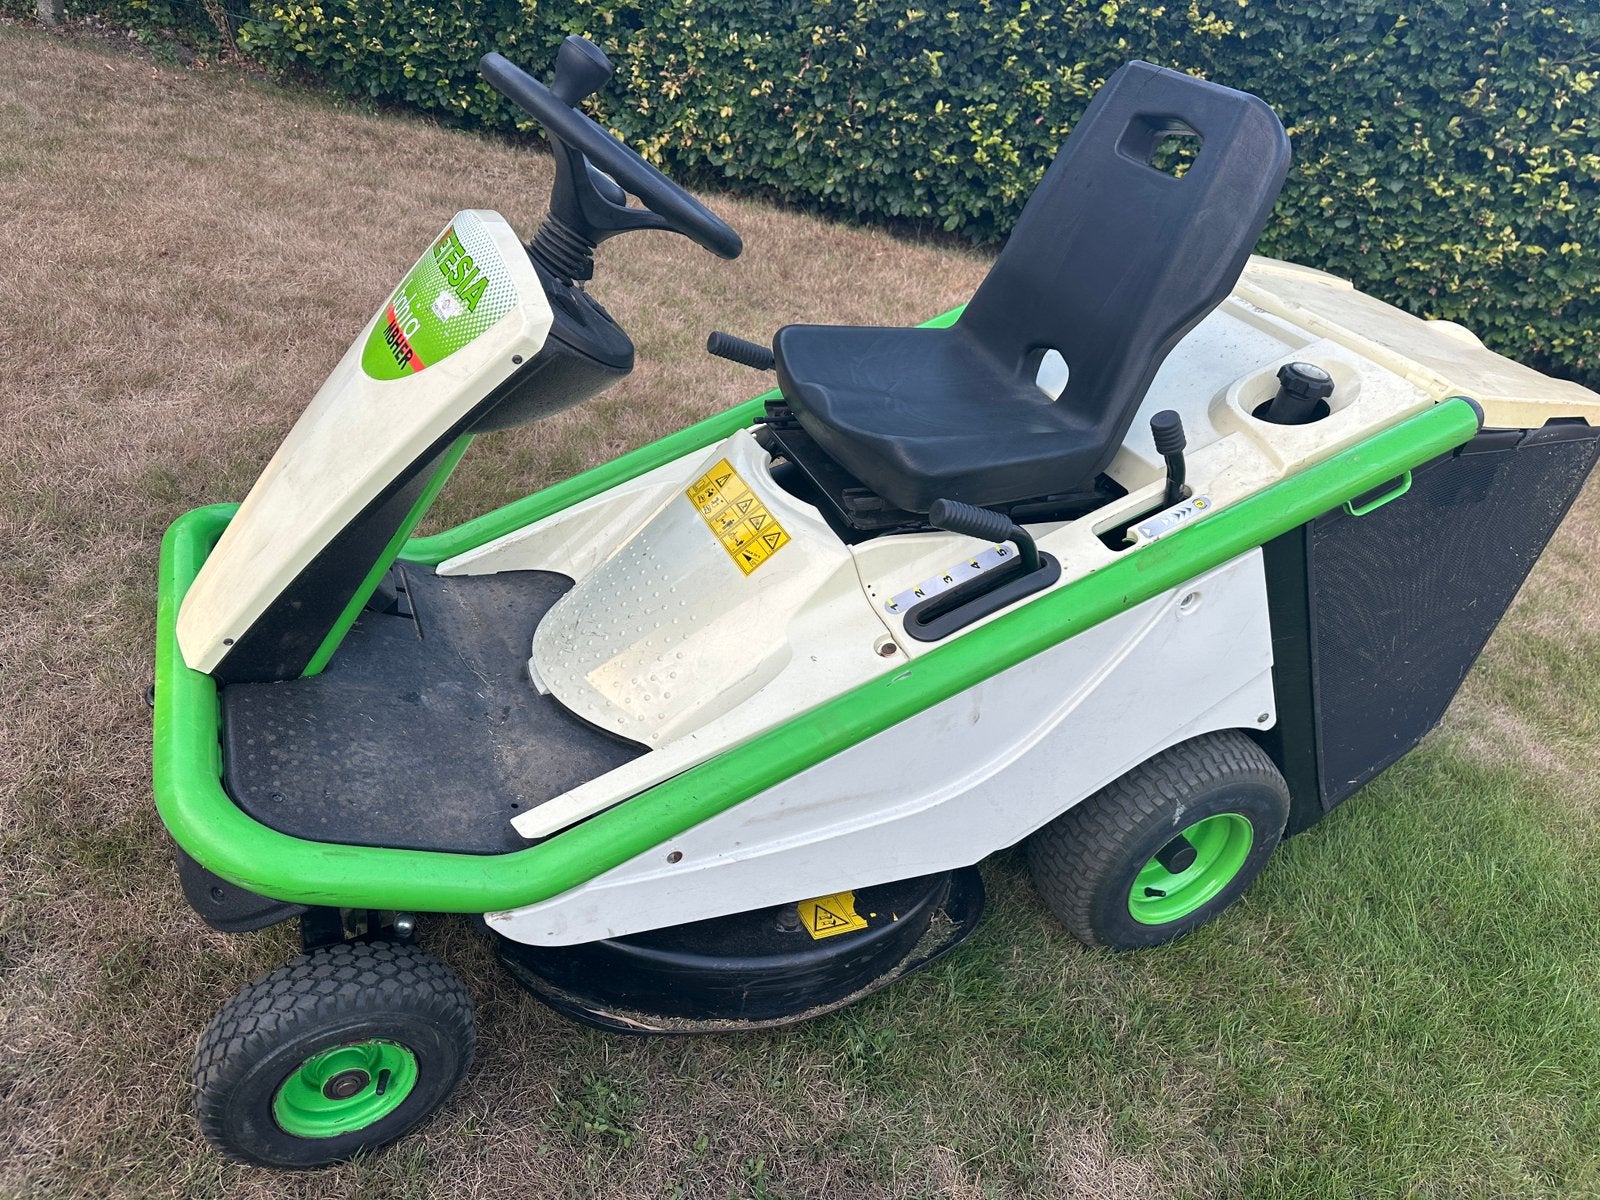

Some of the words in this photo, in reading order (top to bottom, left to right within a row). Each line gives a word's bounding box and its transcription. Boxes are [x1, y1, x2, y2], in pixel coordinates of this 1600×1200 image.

[433, 225, 490, 313] ETESIA
[383, 318, 414, 371] MBHER
[914, 588, 926, 598] 2
[943, 575, 953, 584] 3
[970, 561, 981, 569] 4
[996, 548, 1008, 557] 5
